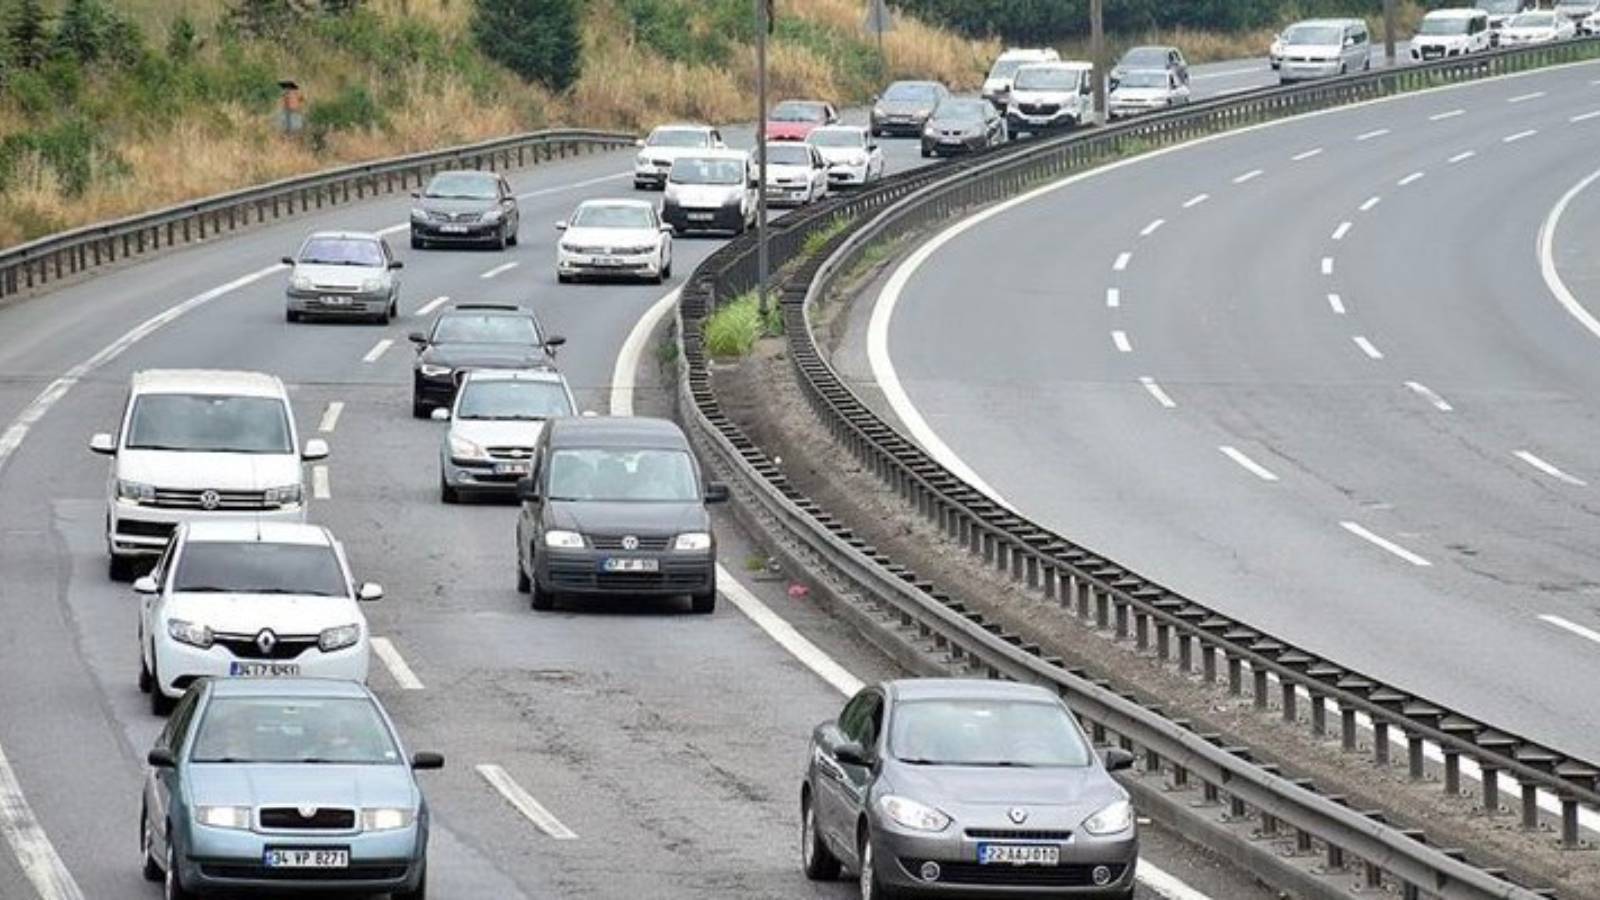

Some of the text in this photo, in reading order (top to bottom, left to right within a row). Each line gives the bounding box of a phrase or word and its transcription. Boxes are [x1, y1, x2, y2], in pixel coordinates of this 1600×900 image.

[272, 851, 288, 865] 34
[315, 851, 345, 865] 8271
[987, 847, 1004, 860] 22
